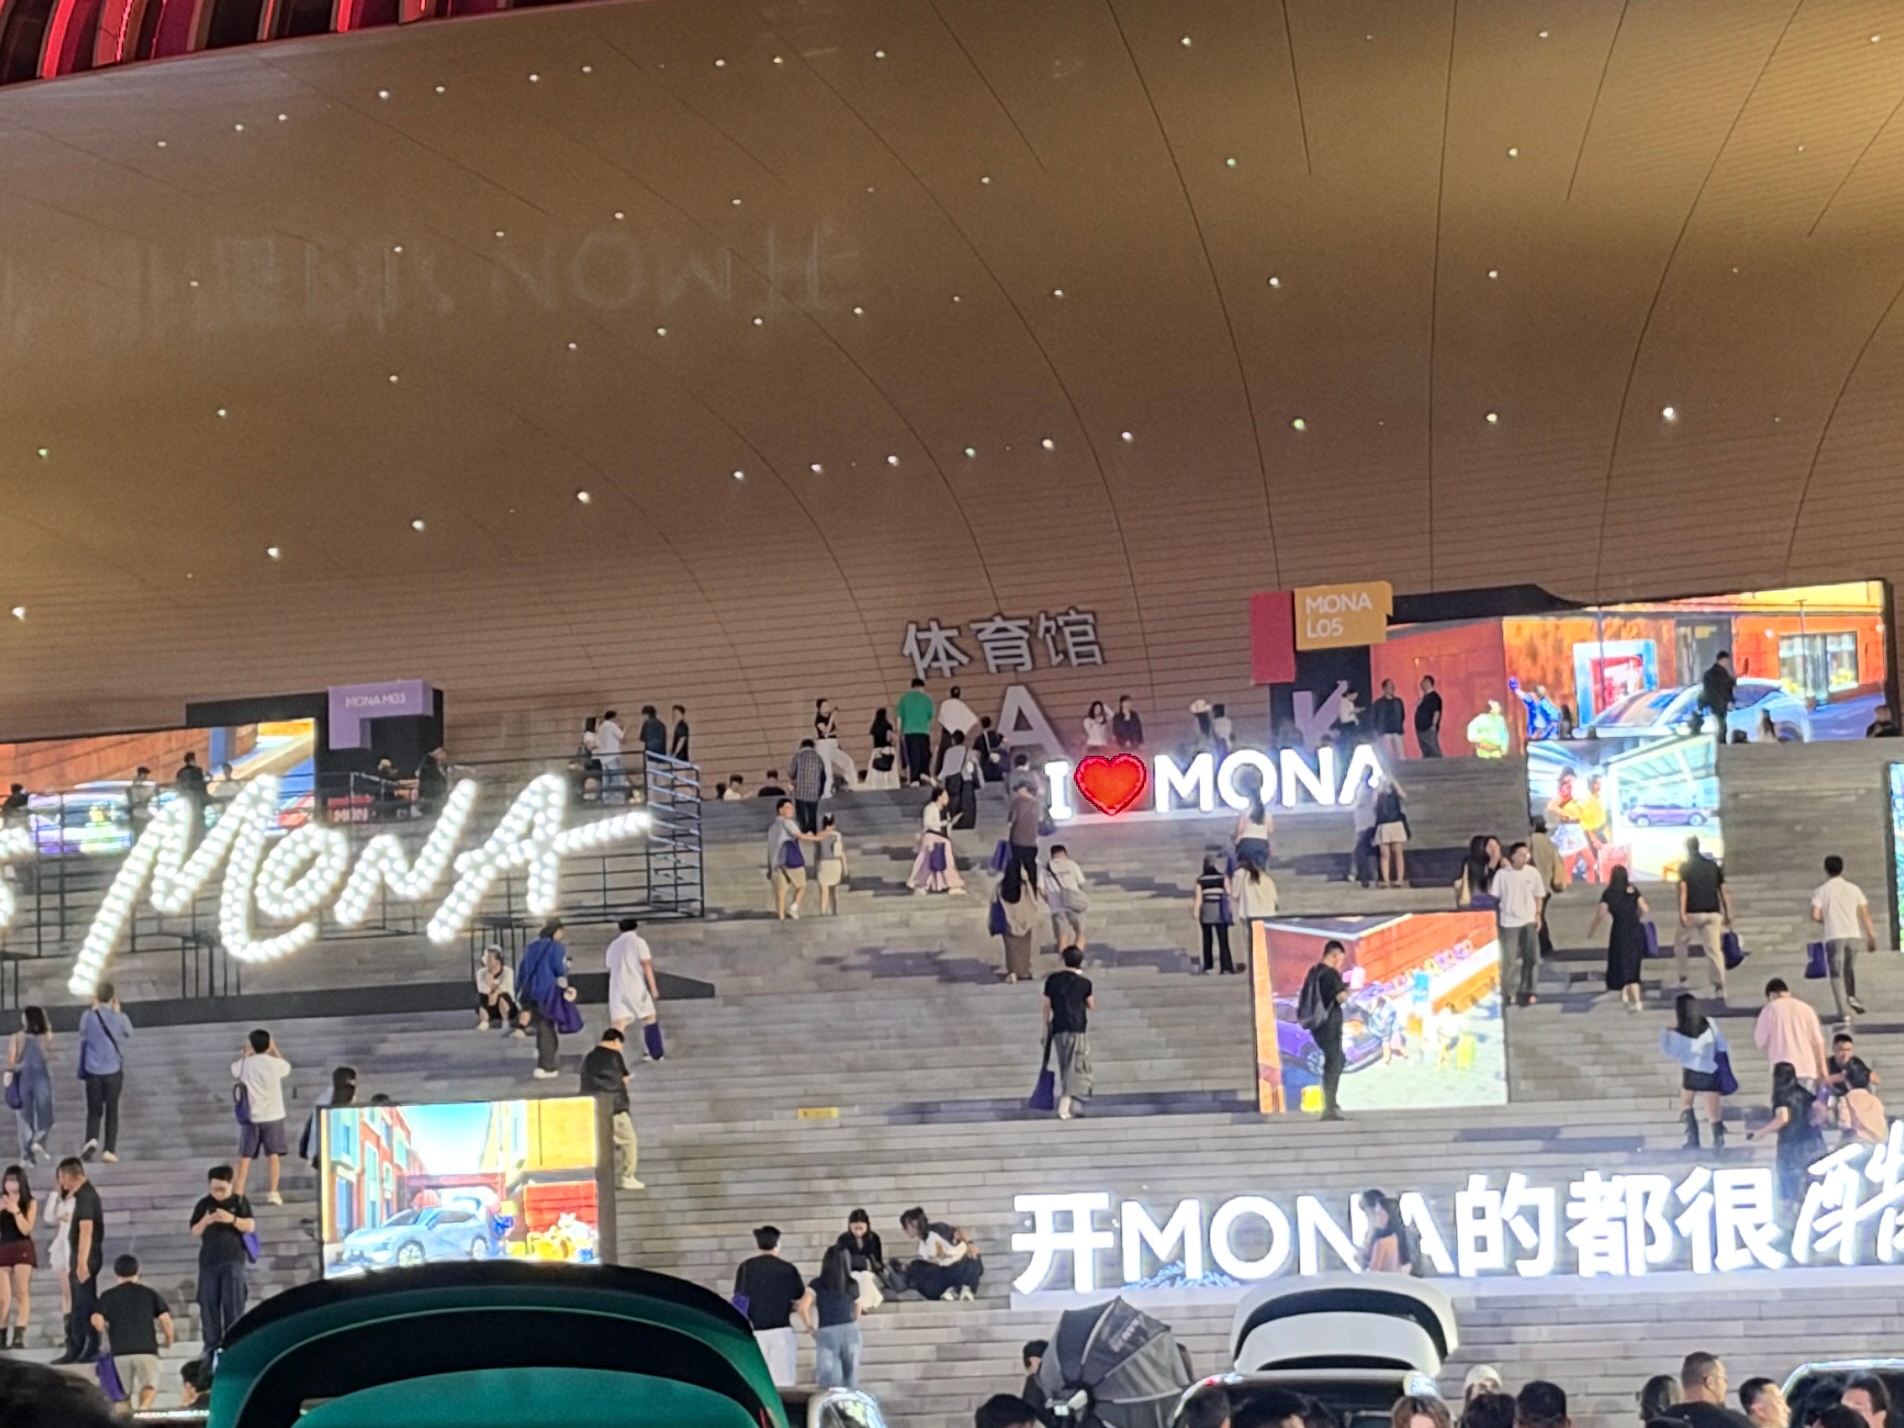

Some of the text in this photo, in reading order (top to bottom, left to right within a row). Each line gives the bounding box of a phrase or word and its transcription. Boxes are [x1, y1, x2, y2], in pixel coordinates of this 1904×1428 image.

[1305, 592, 1373, 615] MONA
[902, 608, 1104, 681] 体育馆
[345, 694, 380, 708] MONA
[1044, 744, 1384, 820] I MONA
